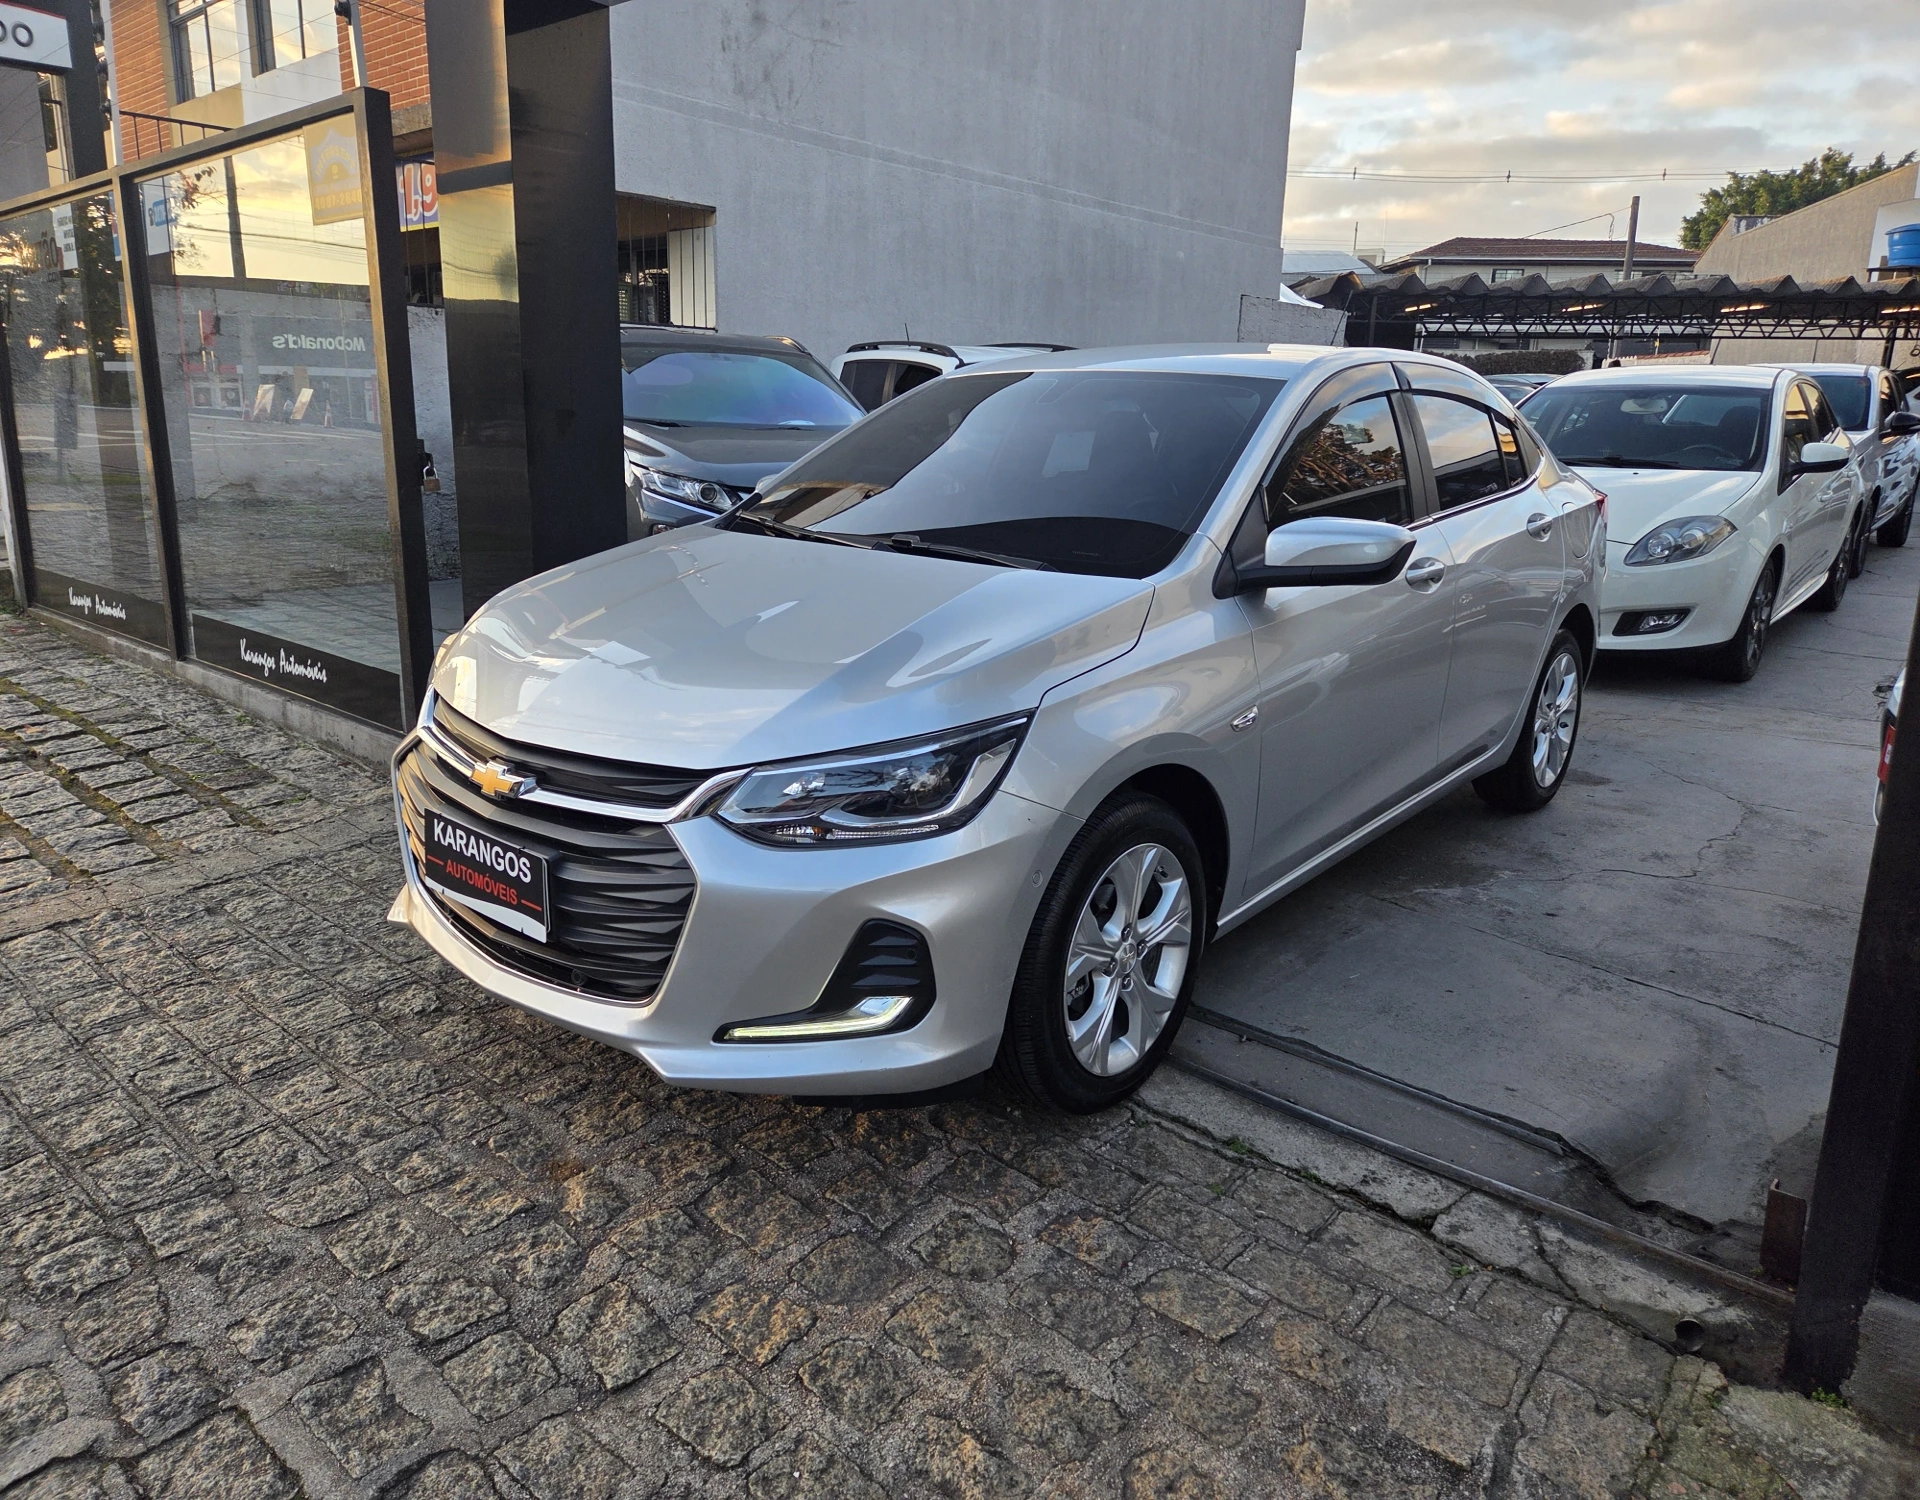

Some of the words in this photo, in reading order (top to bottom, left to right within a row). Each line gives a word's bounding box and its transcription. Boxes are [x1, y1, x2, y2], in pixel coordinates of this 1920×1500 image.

[240, 637, 276, 677] Karangos
[280, 647, 328, 684] Automóveis
[433, 818, 532, 884] KARANGOS
[445, 859, 518, 906] AUTOMÓVEIS
